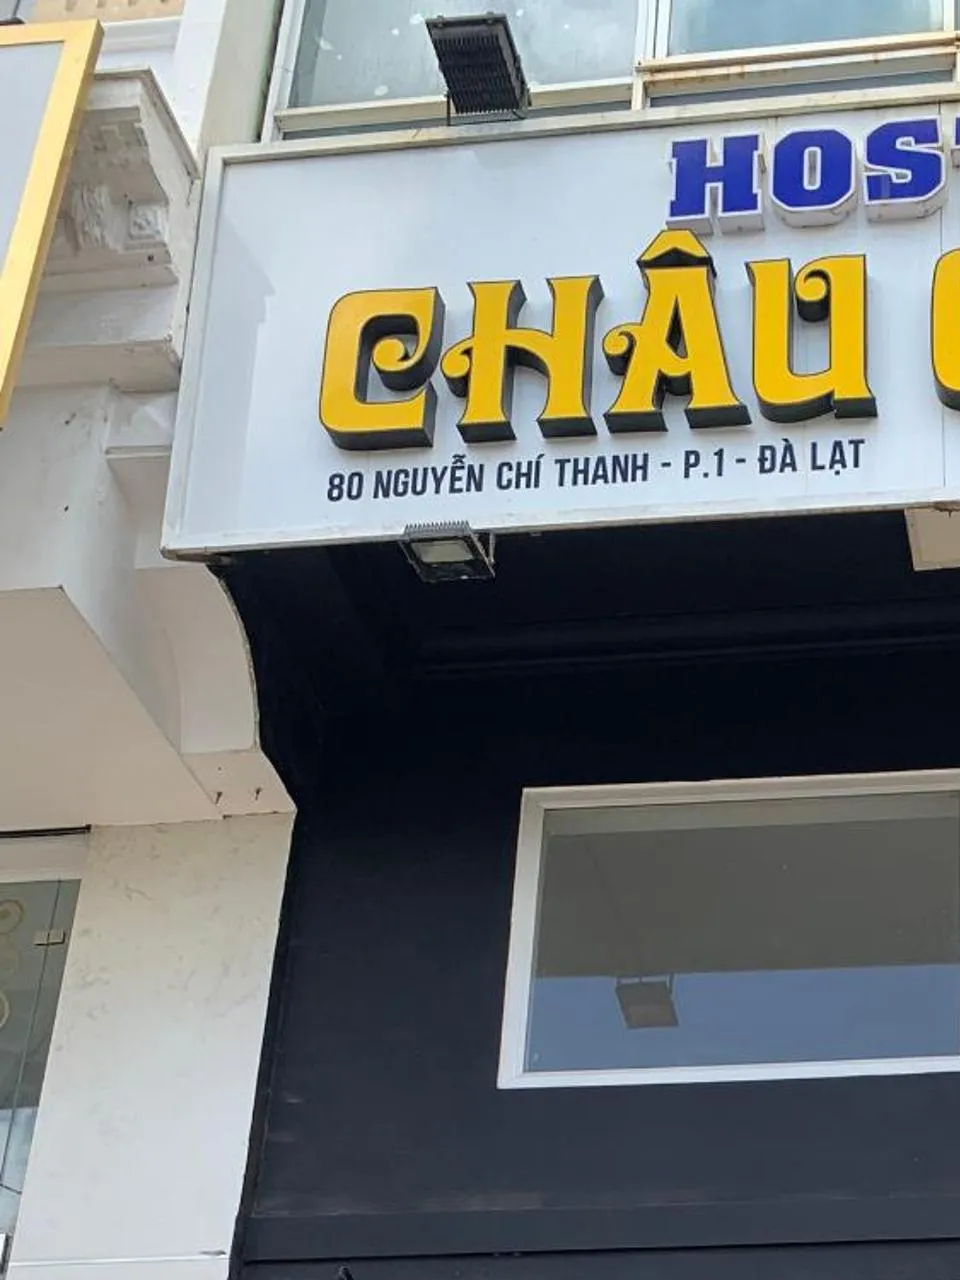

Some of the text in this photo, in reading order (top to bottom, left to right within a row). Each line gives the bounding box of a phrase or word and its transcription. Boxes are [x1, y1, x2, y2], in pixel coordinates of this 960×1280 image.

[319, 229, 878, 450] CHÂU
[327, 473, 364, 502] 80
[373, 454, 484, 499] NGUYỄN
[496, 453, 545, 491] CHÍ
[555, 452, 649, 487] THANH
[684, 448, 725, 479] P.1
[758, 438, 797, 474] ĐÀ
[811, 438, 865, 476] LẠT
